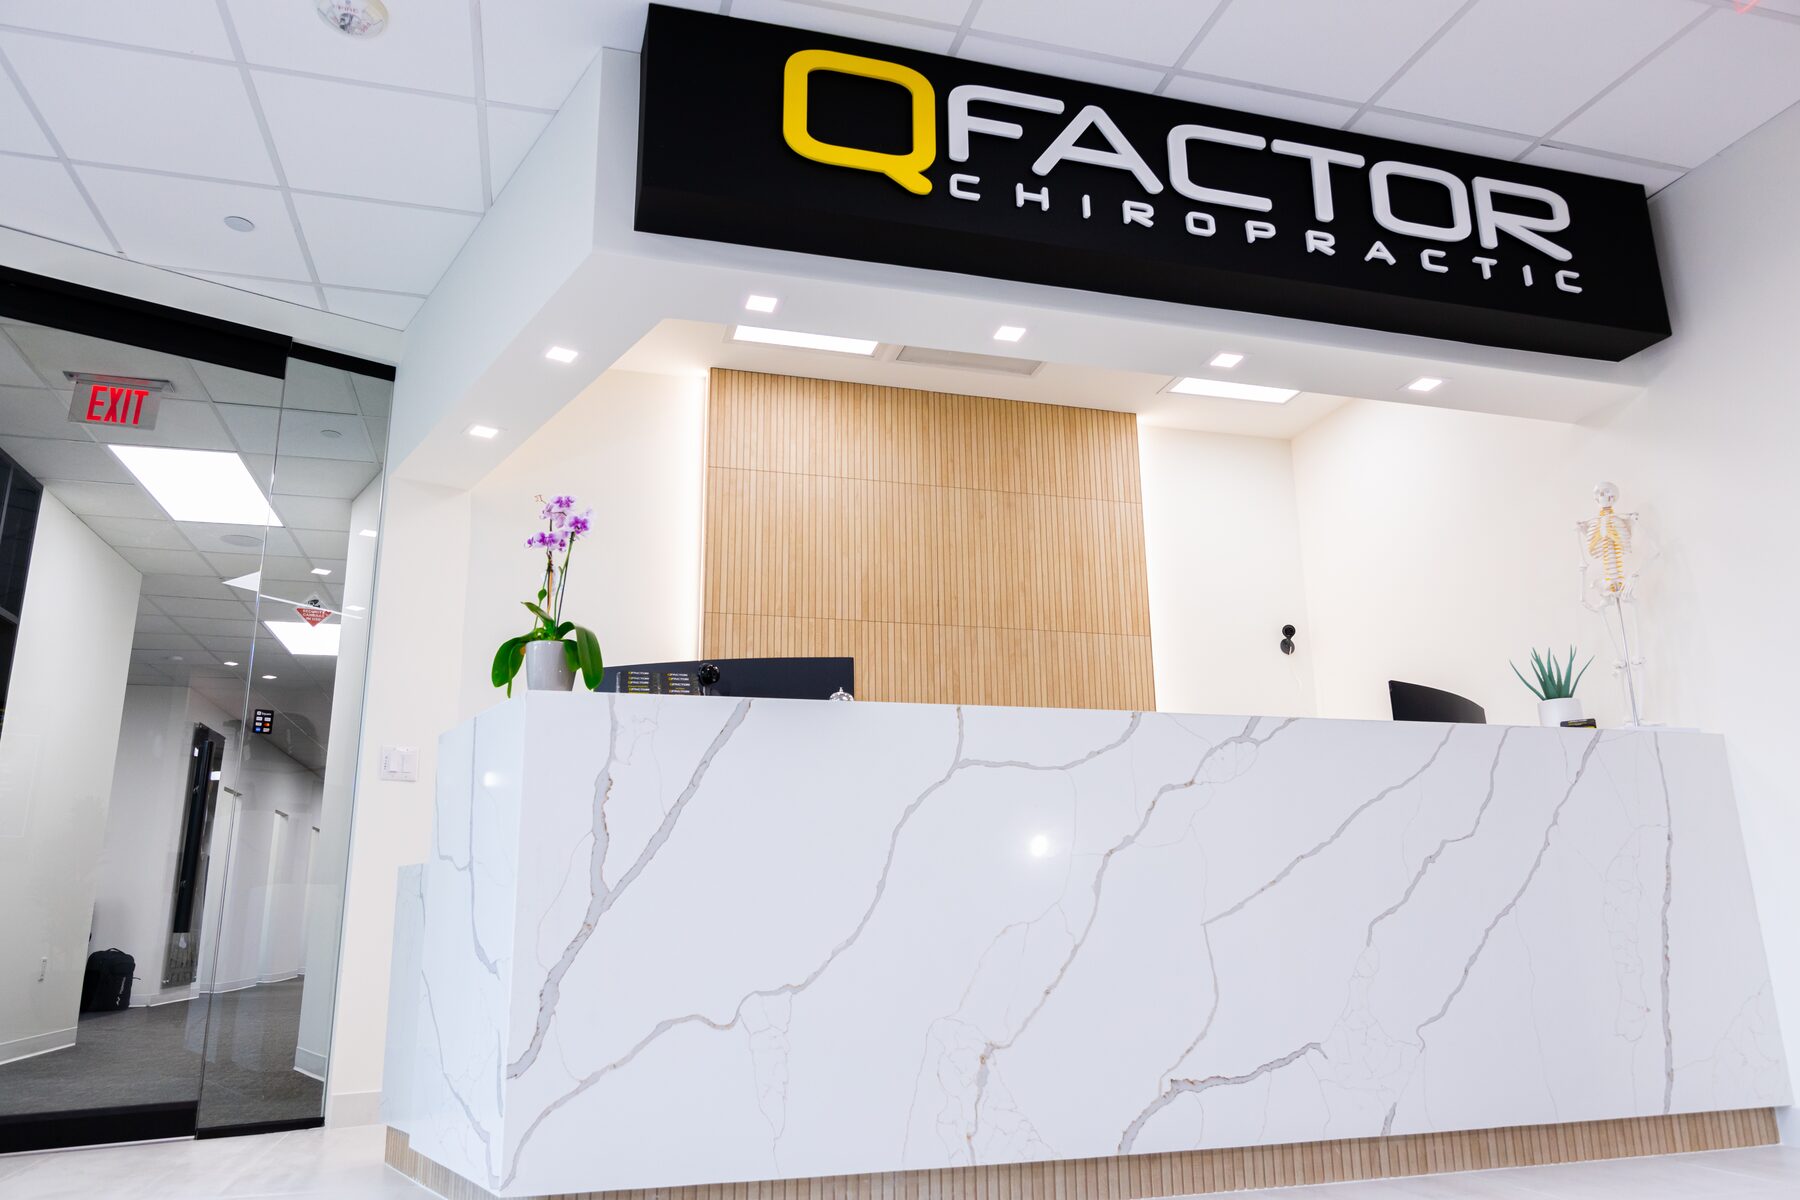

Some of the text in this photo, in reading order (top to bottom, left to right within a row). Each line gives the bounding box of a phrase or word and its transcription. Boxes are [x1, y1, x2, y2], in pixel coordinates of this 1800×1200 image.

[782, 49, 1573, 263] QFACTOR
[949, 173, 1584, 295] CHIROPRACTIC
[86, 384, 149, 425] EXIT
